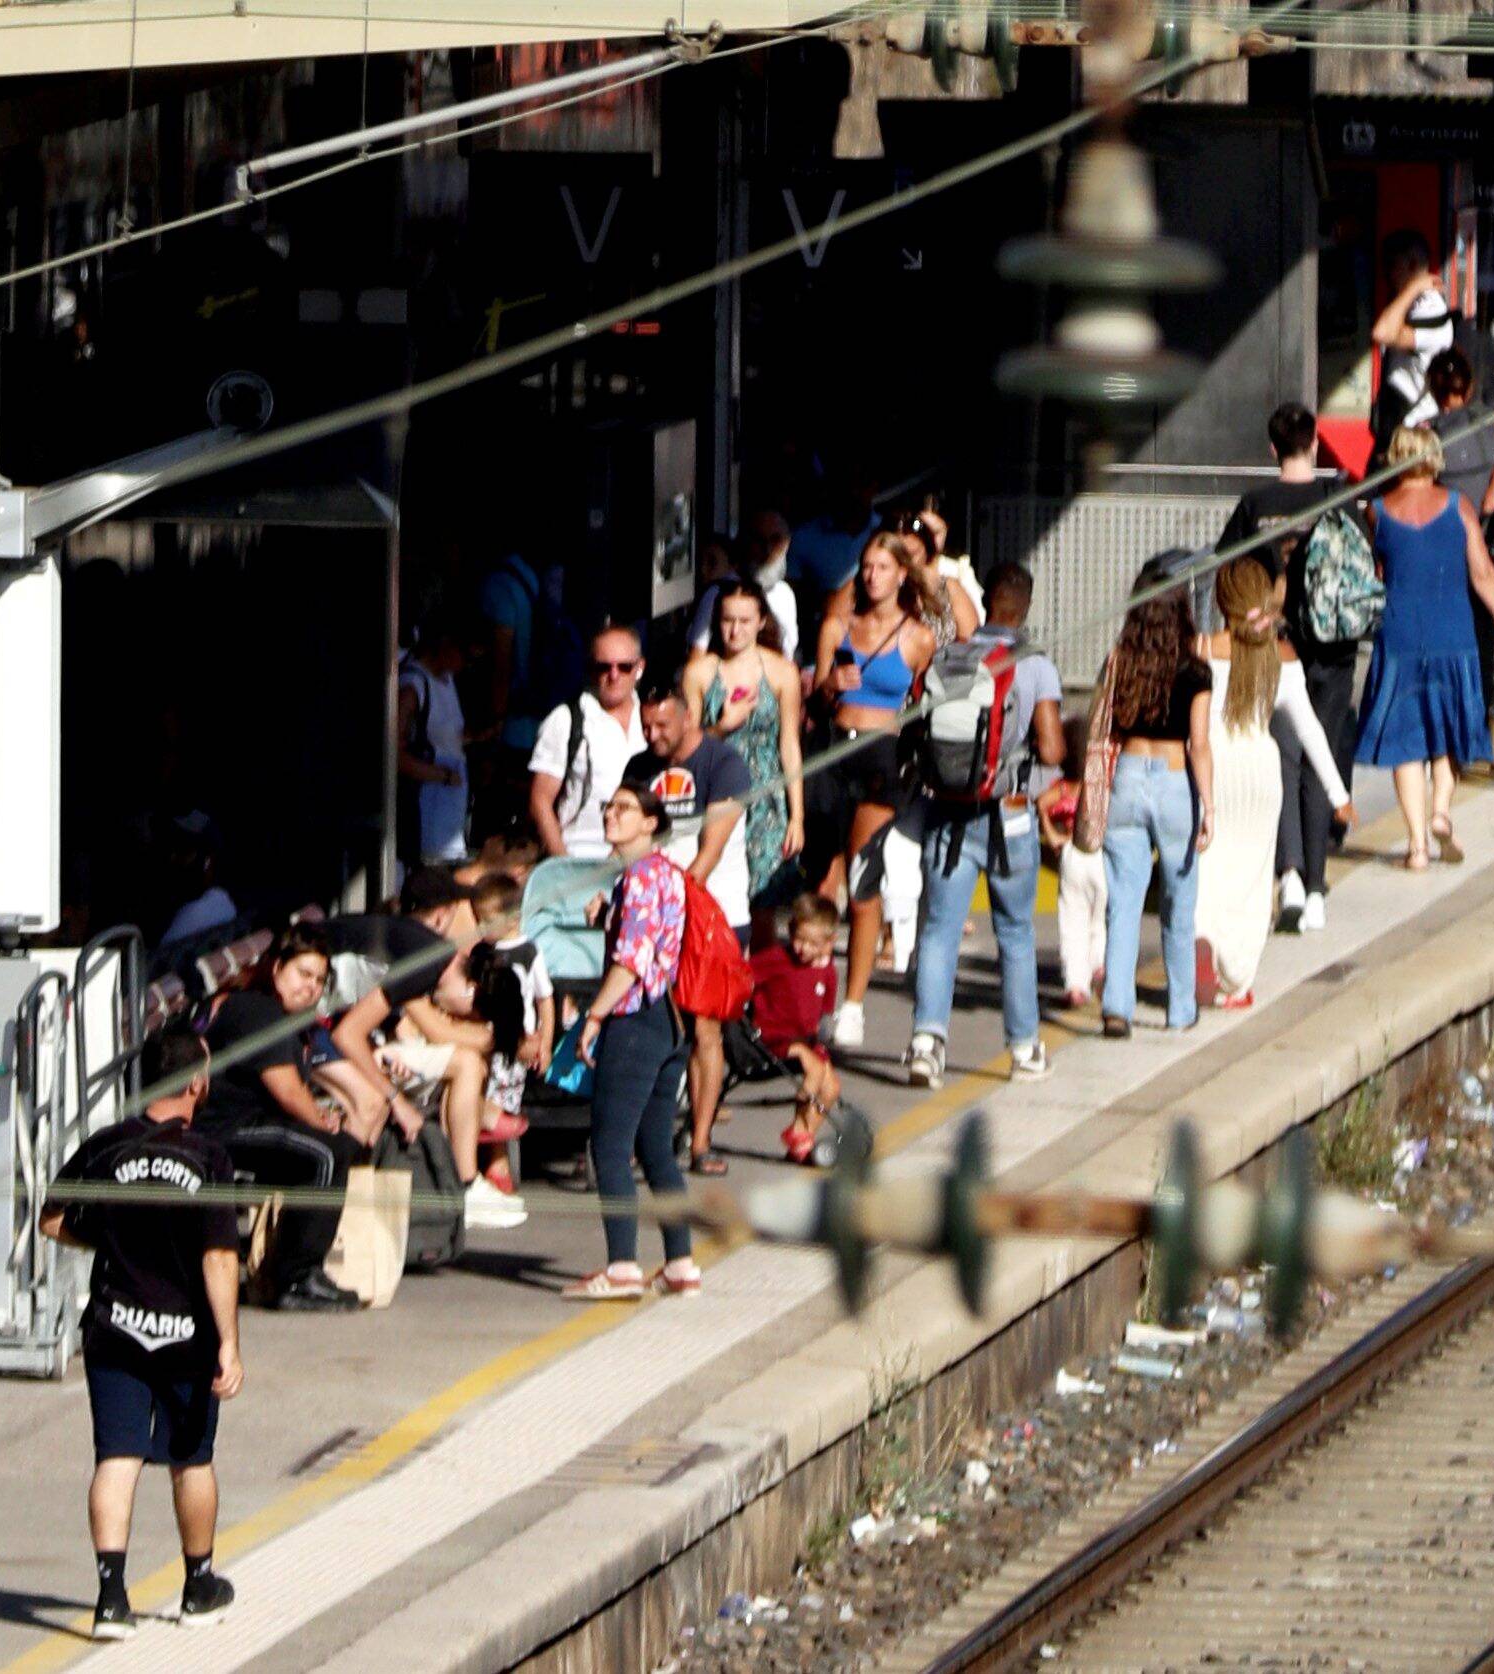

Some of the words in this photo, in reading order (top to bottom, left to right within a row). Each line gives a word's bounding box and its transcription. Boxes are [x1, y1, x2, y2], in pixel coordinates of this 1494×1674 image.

[559, 184, 623, 263] V
[781, 188, 847, 268] V
[114, 1157, 150, 1184] USC
